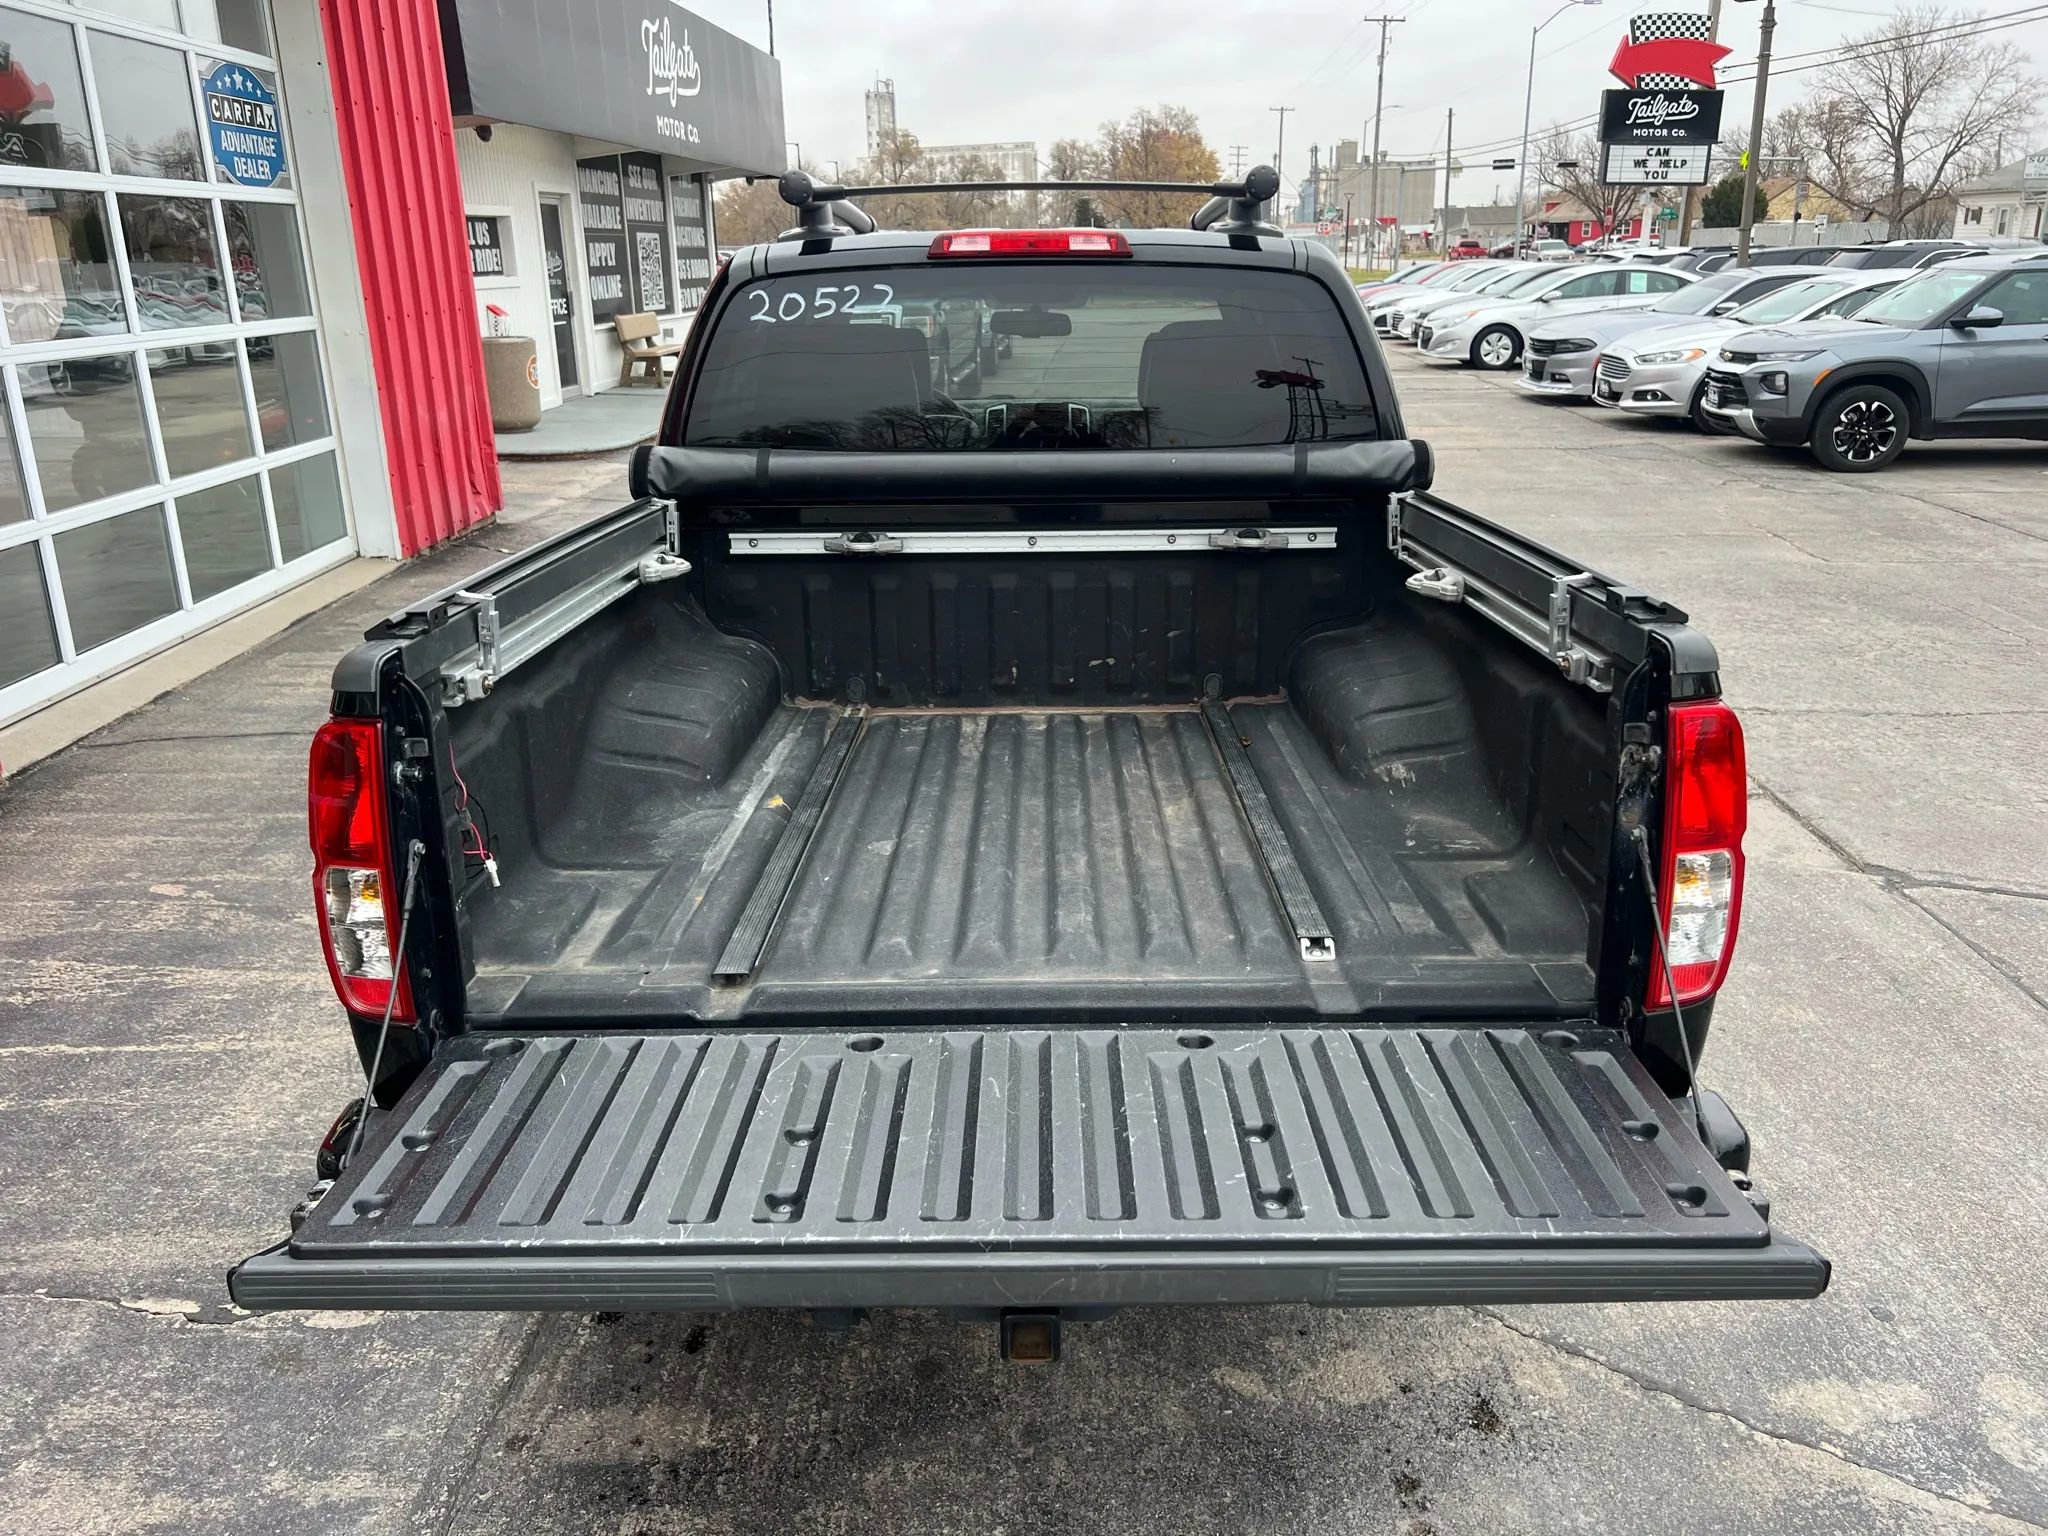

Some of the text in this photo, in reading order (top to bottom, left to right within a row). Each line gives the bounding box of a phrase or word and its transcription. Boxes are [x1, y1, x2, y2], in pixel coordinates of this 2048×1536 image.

[642, 17, 701, 107] Tailgate
[211, 98, 275, 131] CARFAX
[1625, 93, 1700, 126] Tailgate
[656, 115, 686, 141] MOTOR
[1633, 128, 1668, 137] MOTOR
[221, 130, 277, 157] ADVANTAGE
[1646, 147, 1670, 157] CAN
[233, 156, 272, 181] DEALER
[1633, 159, 1688, 169] WE HELP
[1644, 170, 1668, 180] YOU
[628, 164, 643, 189] SEE
[642, 167, 658, 191] OUR
[580, 203, 622, 230] VAILABLE
[625, 196, 664, 222] INVENTORY
[475, 248, 502, 273] RIDE!
[588, 242, 616, 267] APPLY
[590, 274, 623, 301] ONLINE
